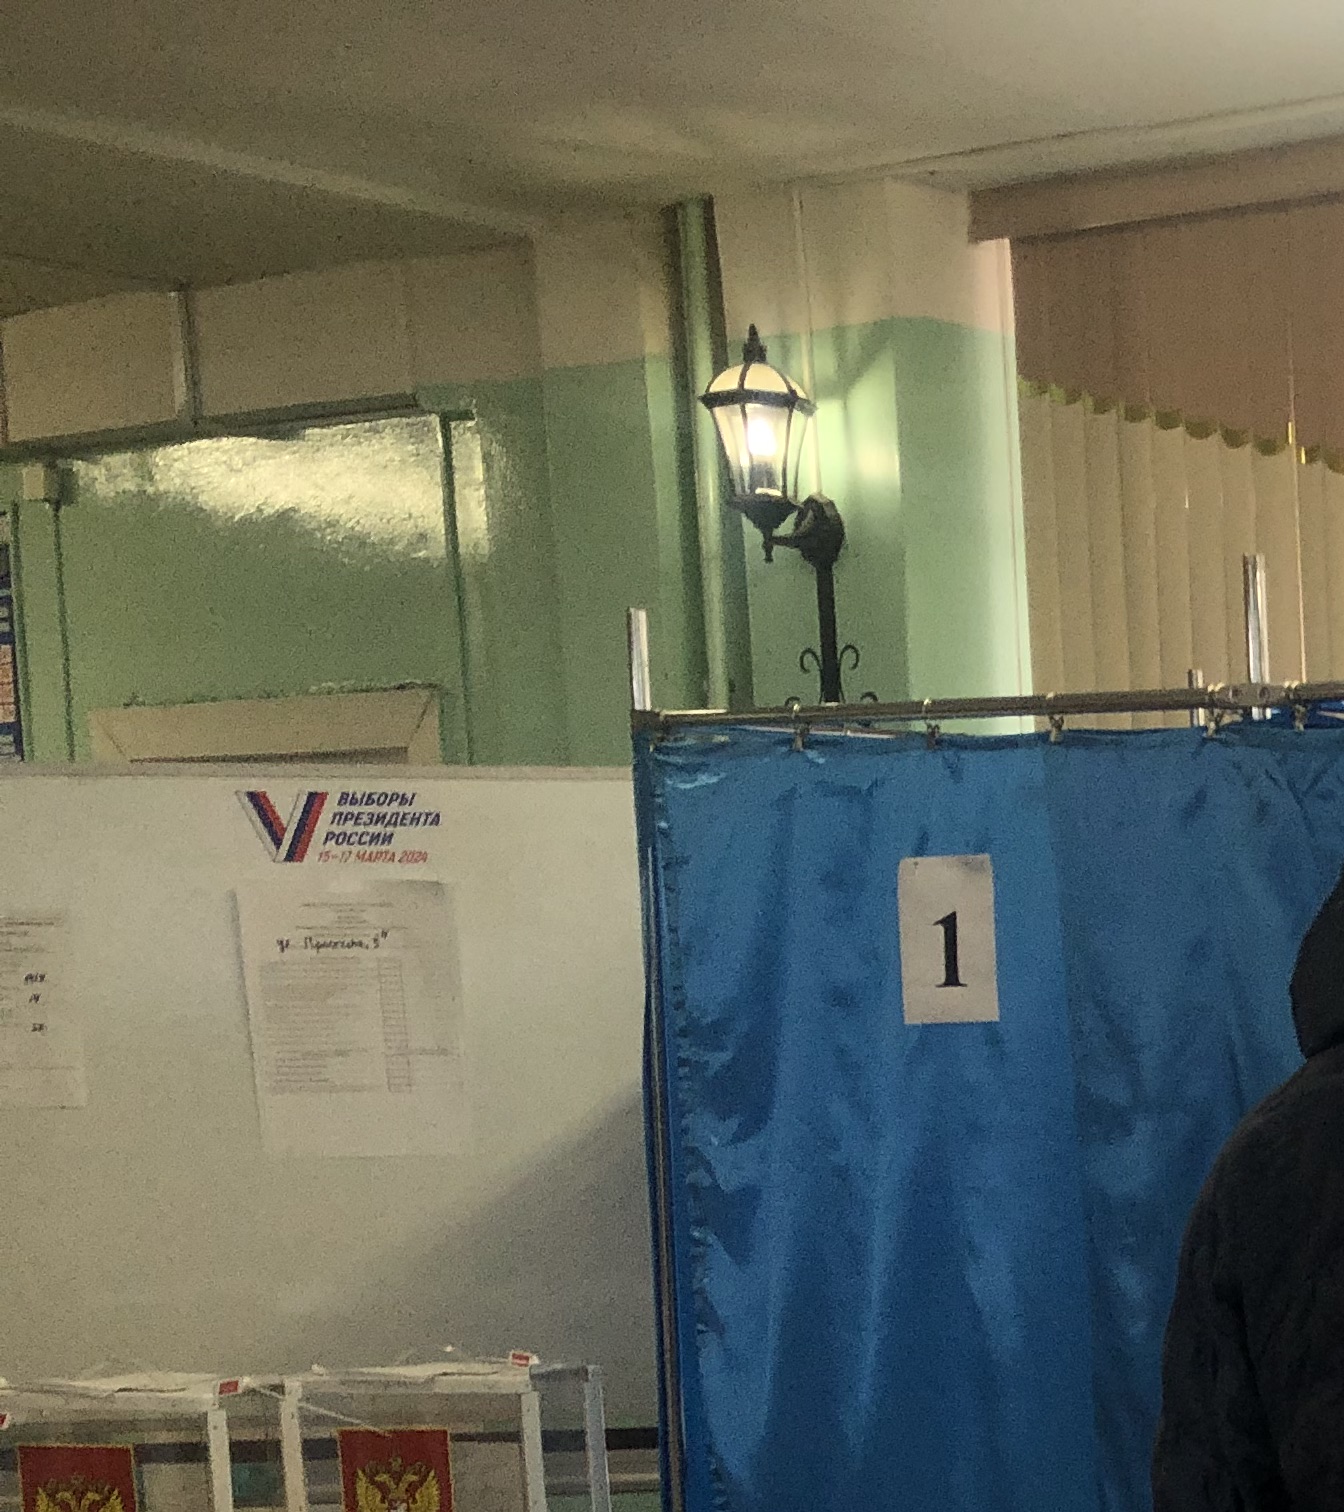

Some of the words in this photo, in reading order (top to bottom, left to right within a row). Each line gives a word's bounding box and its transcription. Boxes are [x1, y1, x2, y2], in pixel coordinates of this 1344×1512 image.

[337, 791, 417, 807] ВЫБОРЫ
[331, 811, 442, 828] ПРЕЗИДЕНТА
[322, 831, 395, 846] РОССИИ
[355, 851, 396, 864] МАРТА
[398, 851, 429, 864] 2024
[932, 910, 968, 988] 1
